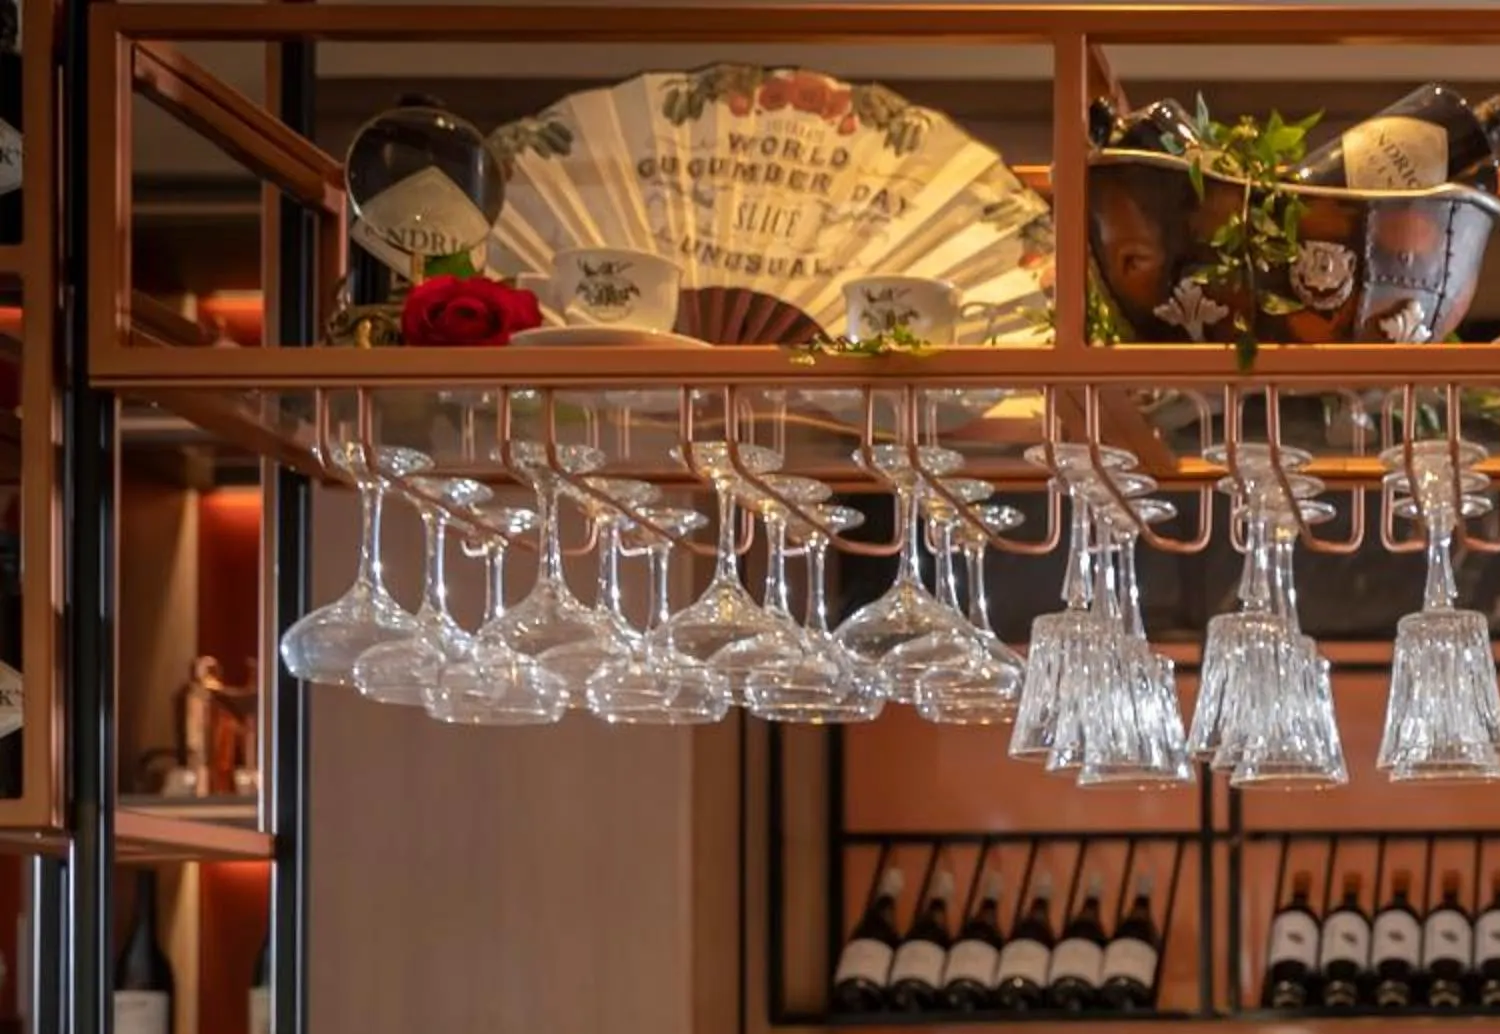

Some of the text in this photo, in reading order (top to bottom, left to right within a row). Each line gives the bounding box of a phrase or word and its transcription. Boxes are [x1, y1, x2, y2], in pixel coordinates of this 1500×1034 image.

[728, 132, 850, 170] WORLD
[637, 156, 833, 195] CUCUMBER
[680, 234, 833, 280] UNUSUAL
